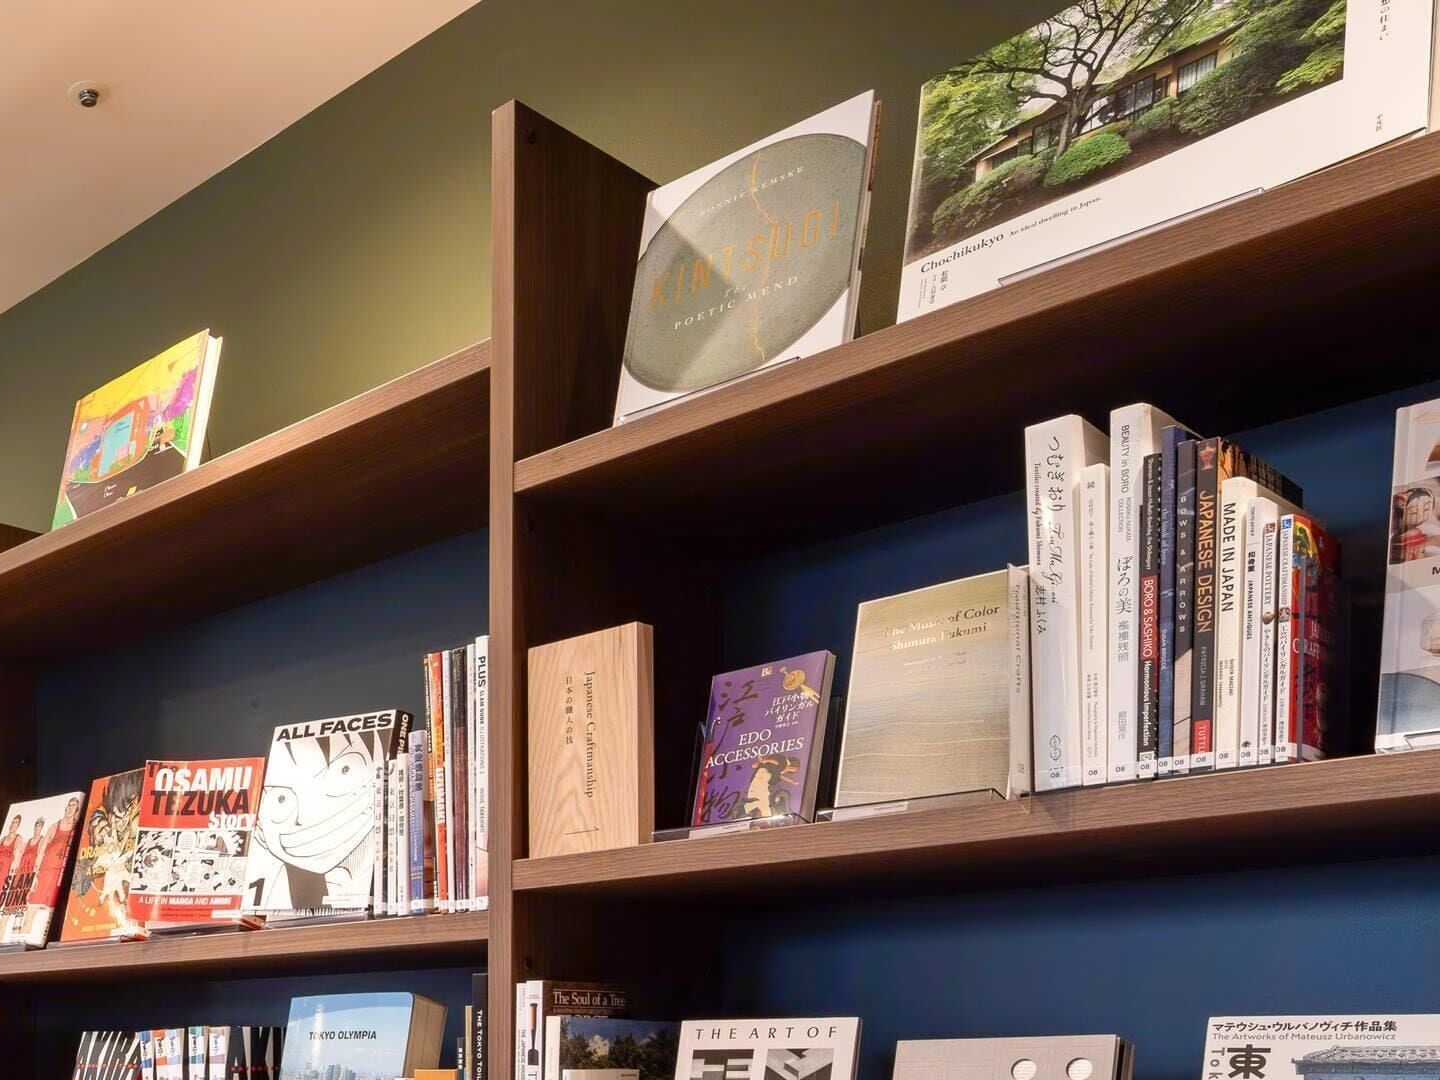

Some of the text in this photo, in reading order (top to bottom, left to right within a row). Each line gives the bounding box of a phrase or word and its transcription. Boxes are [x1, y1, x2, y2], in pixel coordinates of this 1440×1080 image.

[699, 165, 805, 217] BONNIE KEMSKE
[920, 195, 1104, 274] Chochikukyo An ideal dwelling in Japan.
[648, 199, 841, 309] KINTSUGI
[673, 275, 801, 331] POETIC MEND
[1121, 424, 1130, 456] BEAUTY
[1033, 462, 1042, 485] Textiles
[1047, 436, 1066, 513] つむぎおり
[1121, 458, 1129, 468] in
[1121, 469, 1130, 494] BORO
[1161, 508, 1170, 565] the book boro
[1178, 495, 1188, 633] BOWS ARROWS
[1197, 490, 1215, 634] JAPANESE DESIGN
[1221, 502, 1237, 613] MADE IN JAPAN
[1264, 534, 1273, 606] JAPANESE POTTERY
[1280, 530, 1290, 606] JAPANESE CRAFTSMANSHIP
[1116, 555, 1133, 615] ぼろの美
[946, 609, 962, 624] of
[964, 605, 1001, 621] Color
[1142, 579, 1154, 658] BORO & SASHIKO
[889, 636, 937, 652] Shimura
[478, 655, 486, 688] PLUS
[565, 676, 574, 745] 日本の職人の技
[776, 711, 800, 723] ガイド
[1142, 660, 1152, 747] Harmonious Imperfection
[276, 713, 393, 743] ALL FACES
[399, 713, 409, 738] ONE
[583, 671, 597, 799] Japanese Craftmanship
[737, 728, 772, 746] EDO
[705, 736, 806, 768] ACCESSORIES
[154, 766, 253, 794] OSAMU
[149, 789, 250, 816] TEZUKA
[208, 812, 257, 831] Story
[1, 871, 37, 892] SLAM
[248, 877, 266, 906] 1
[160, 897, 168, 905] IN
[169, 897, 194, 905] MANGA
[194, 897, 209, 905] AND
[209, 896, 233, 905] ANIME
[553, 991, 570, 1006] The
[571, 992, 591, 1006] Soul
[592, 993, 602, 1006] of
[308, 1030, 378, 1041] TOKYO OLYMPIA
[695, 1025, 840, 1041] THE ART OF
[1212, 1020, 1399, 1033] マテウシュ・ウルバノヴィチ作品集
[1212, 1032, 1397, 1042] The Artworks of Mateusz Urbanowicz
